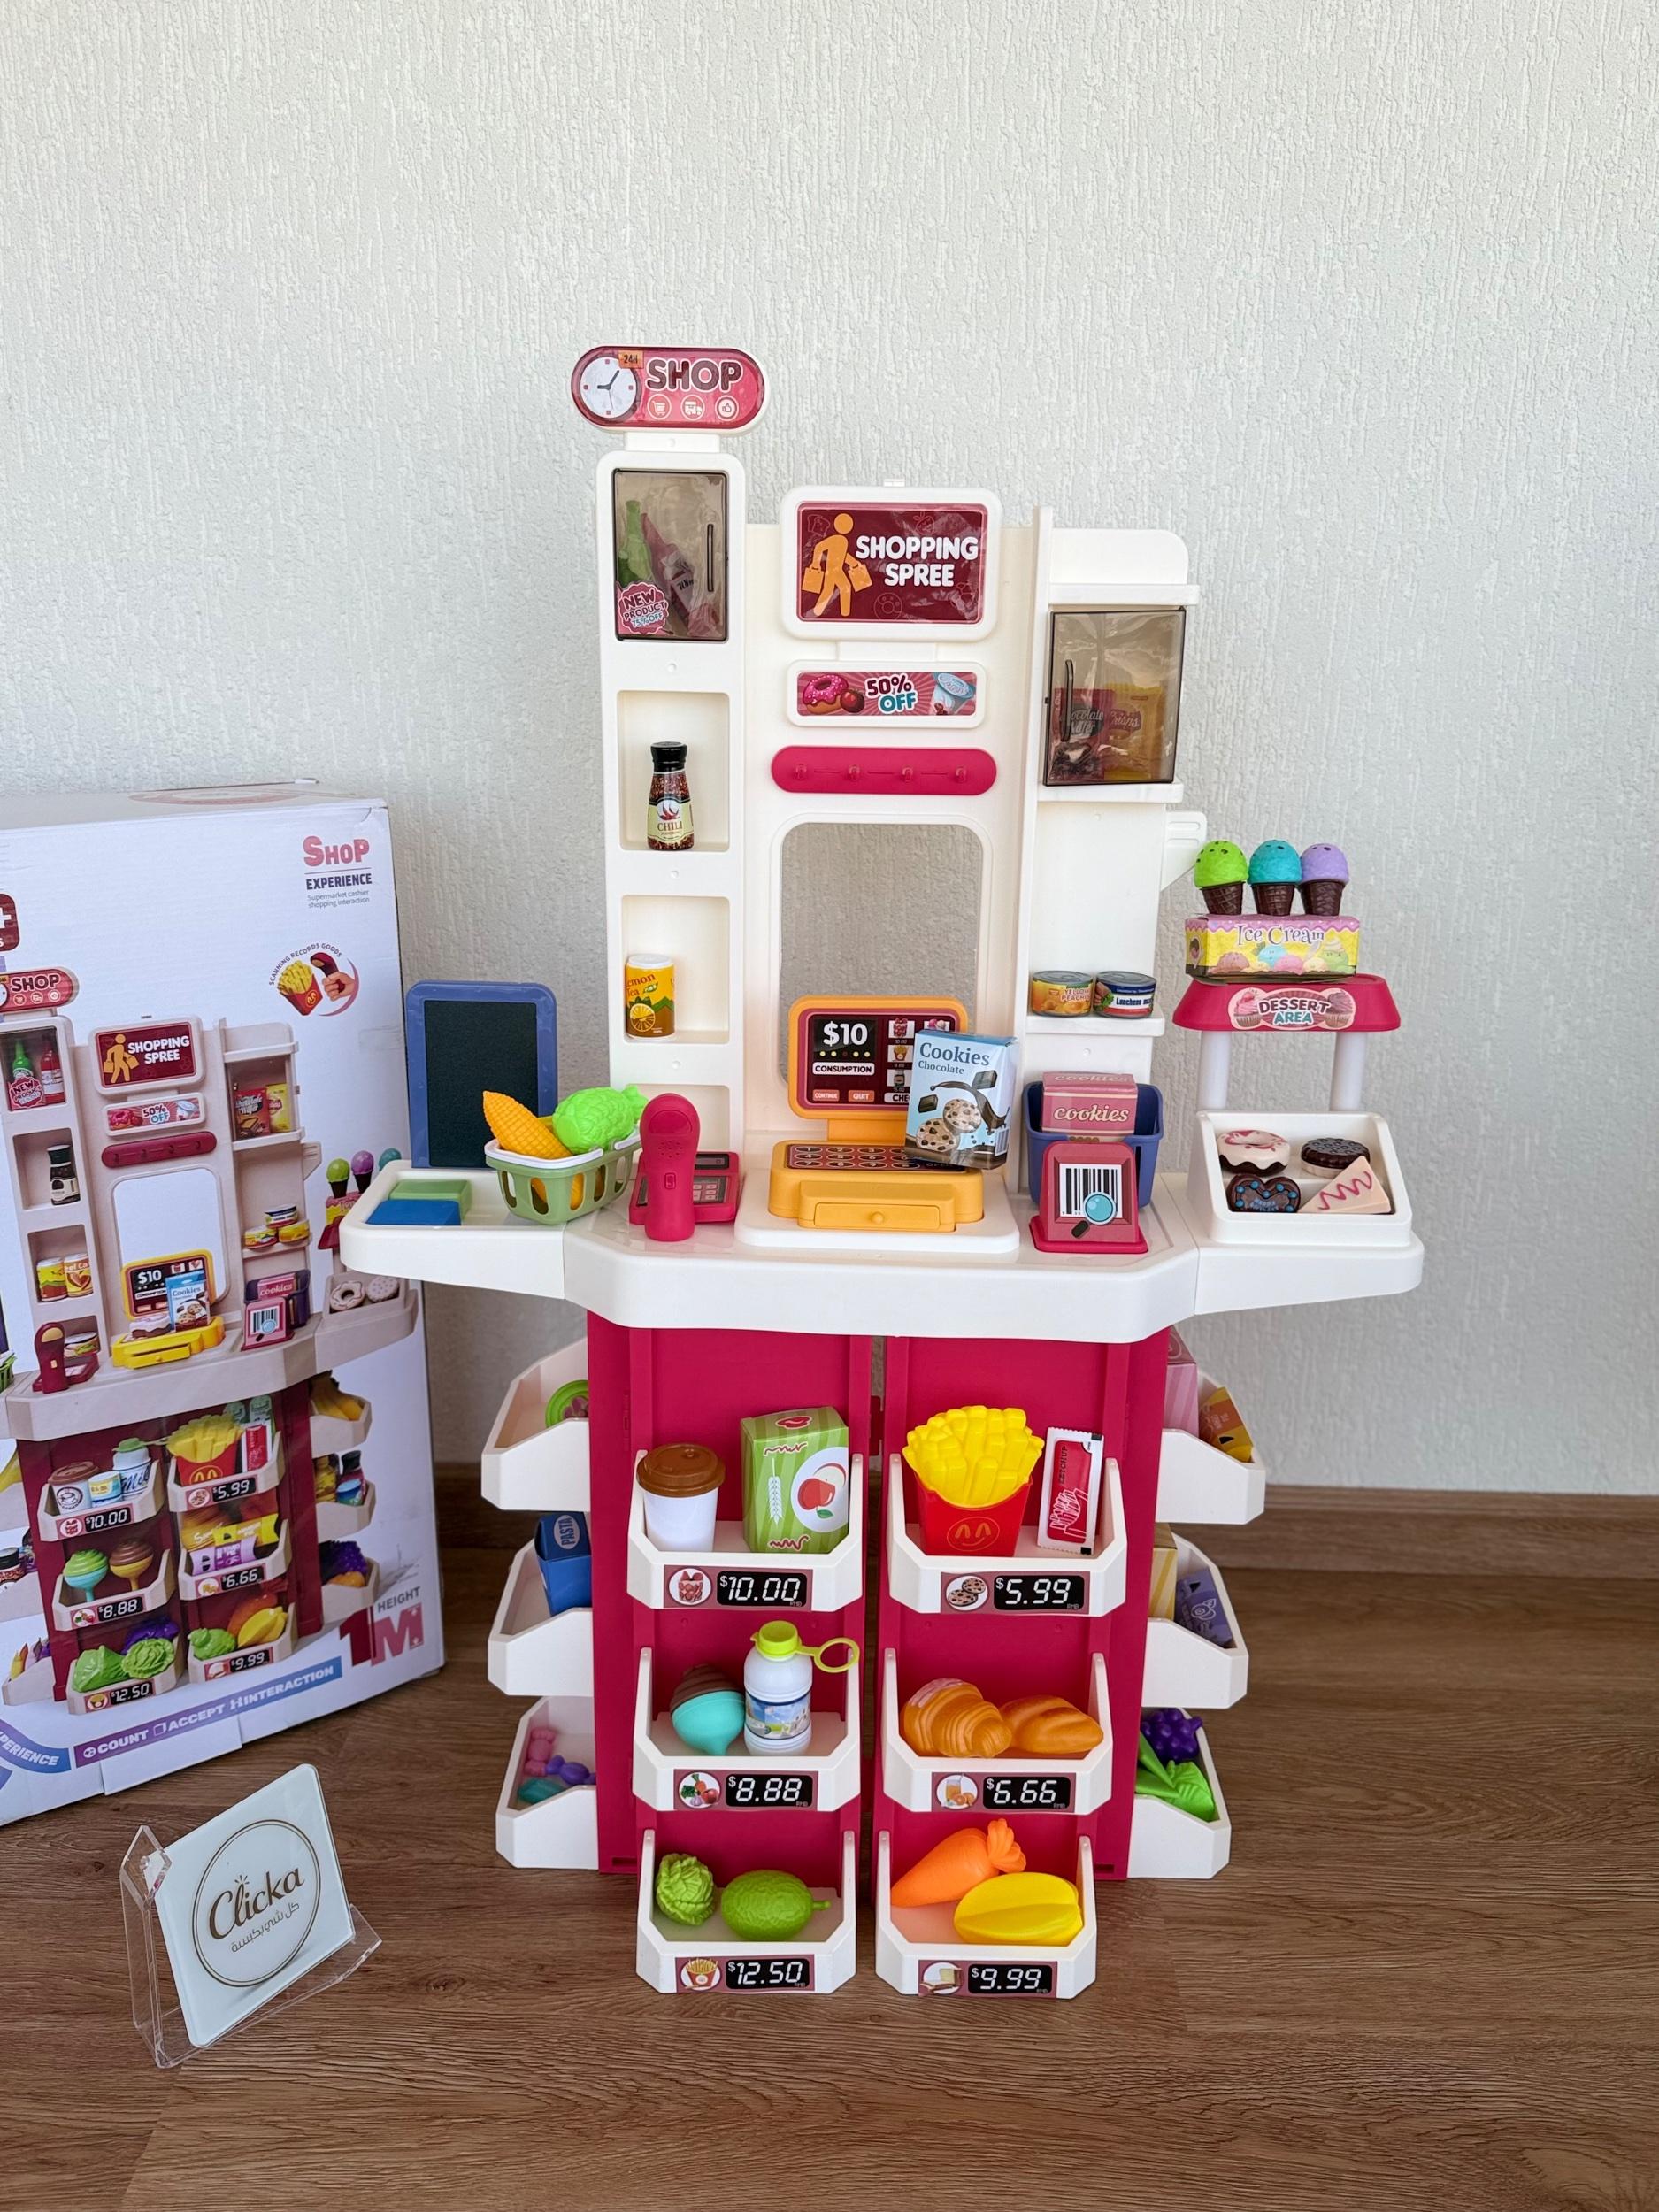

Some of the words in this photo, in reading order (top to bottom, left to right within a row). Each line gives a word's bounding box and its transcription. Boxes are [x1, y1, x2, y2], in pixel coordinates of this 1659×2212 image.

[623, 354, 639, 365] 24H
[646, 358, 742, 391] SHOP
[855, 535, 979, 561] SHOPPING
[885, 563, 955, 587] SPREE
[623, 588, 655, 610] NEW
[624, 601, 665, 620] PRODUCT
[866, 675, 912, 697] 50%
[879, 692, 917, 712] OFF
[657, 820, 682, 832] CHILI
[305, 872, 373, 890] EXPERIENCE
[307, 892, 347, 902] Supermarket
[348, 889, 370, 898] cashier
[308, 901, 336, 910] shopping
[337, 897, 370, 906] interaction
[1236, 924, 1263, 946] Ice
[1268, 926, 1325, 945] Cream
[269, 956, 291, 986] SCANNING
[290, 942, 319, 958] RECORDS
[321, 942, 342, 957] GOODS
[12, 974, 60, 992] SHOP
[1259, 998, 1330, 1014] DESSERT
[1274, 1011, 1314, 1025] AREA
[823, 1020, 869, 1048] $10
[128, 1035, 190, 1055] SHOPPING
[919, 1042, 990, 1066] Cookies
[144, 1049, 180, 1064] SPREE
[918, 1060, 964, 1075] Chocolate
[13, 1080, 35, 1094] NEW
[143, 1105, 166, 1118] 50%
[150, 1111, 170, 1124] OFF
[1054, 1104, 1129, 1123] cookies
[138, 1270, 162, 1285] $10
[172, 1286, 201, 1297] Cookies
[259, 1284, 293, 1295] cookies
[212, 1479, 250, 1500] $5.99
[86, 1509, 128, 1530] $10.00
[557, 1517, 576, 1546] PASTA
[222, 1568, 259, 1588] $6.66
[719, 1576, 800, 1601] $10.00
[377, 1586, 421, 1613] HEIGHT
[995, 1578, 1071, 1604] $5.99
[98, 1598, 138, 1619] $8.88
[230, 1652, 265, 1670] $9.99
[111, 1683, 150, 1701] $12.50
[243, 1664, 334, 1709] INTERACTION
[168, 1705, 225, 1732] ACCEPT
[0, 1731, 59, 1766] PERIENCE
[97, 1730, 149, 1755] COUNT
[728, 1776, 803, 1802] $8.88
[986, 1778, 1057, 1804] $6.66
[210, 1868, 304, 1939] Clicka
[285, 1902, 299, 1919] كل
[728, 1961, 803, 1985] $12.50
[971, 1968, 1041, 1990] $9.99
